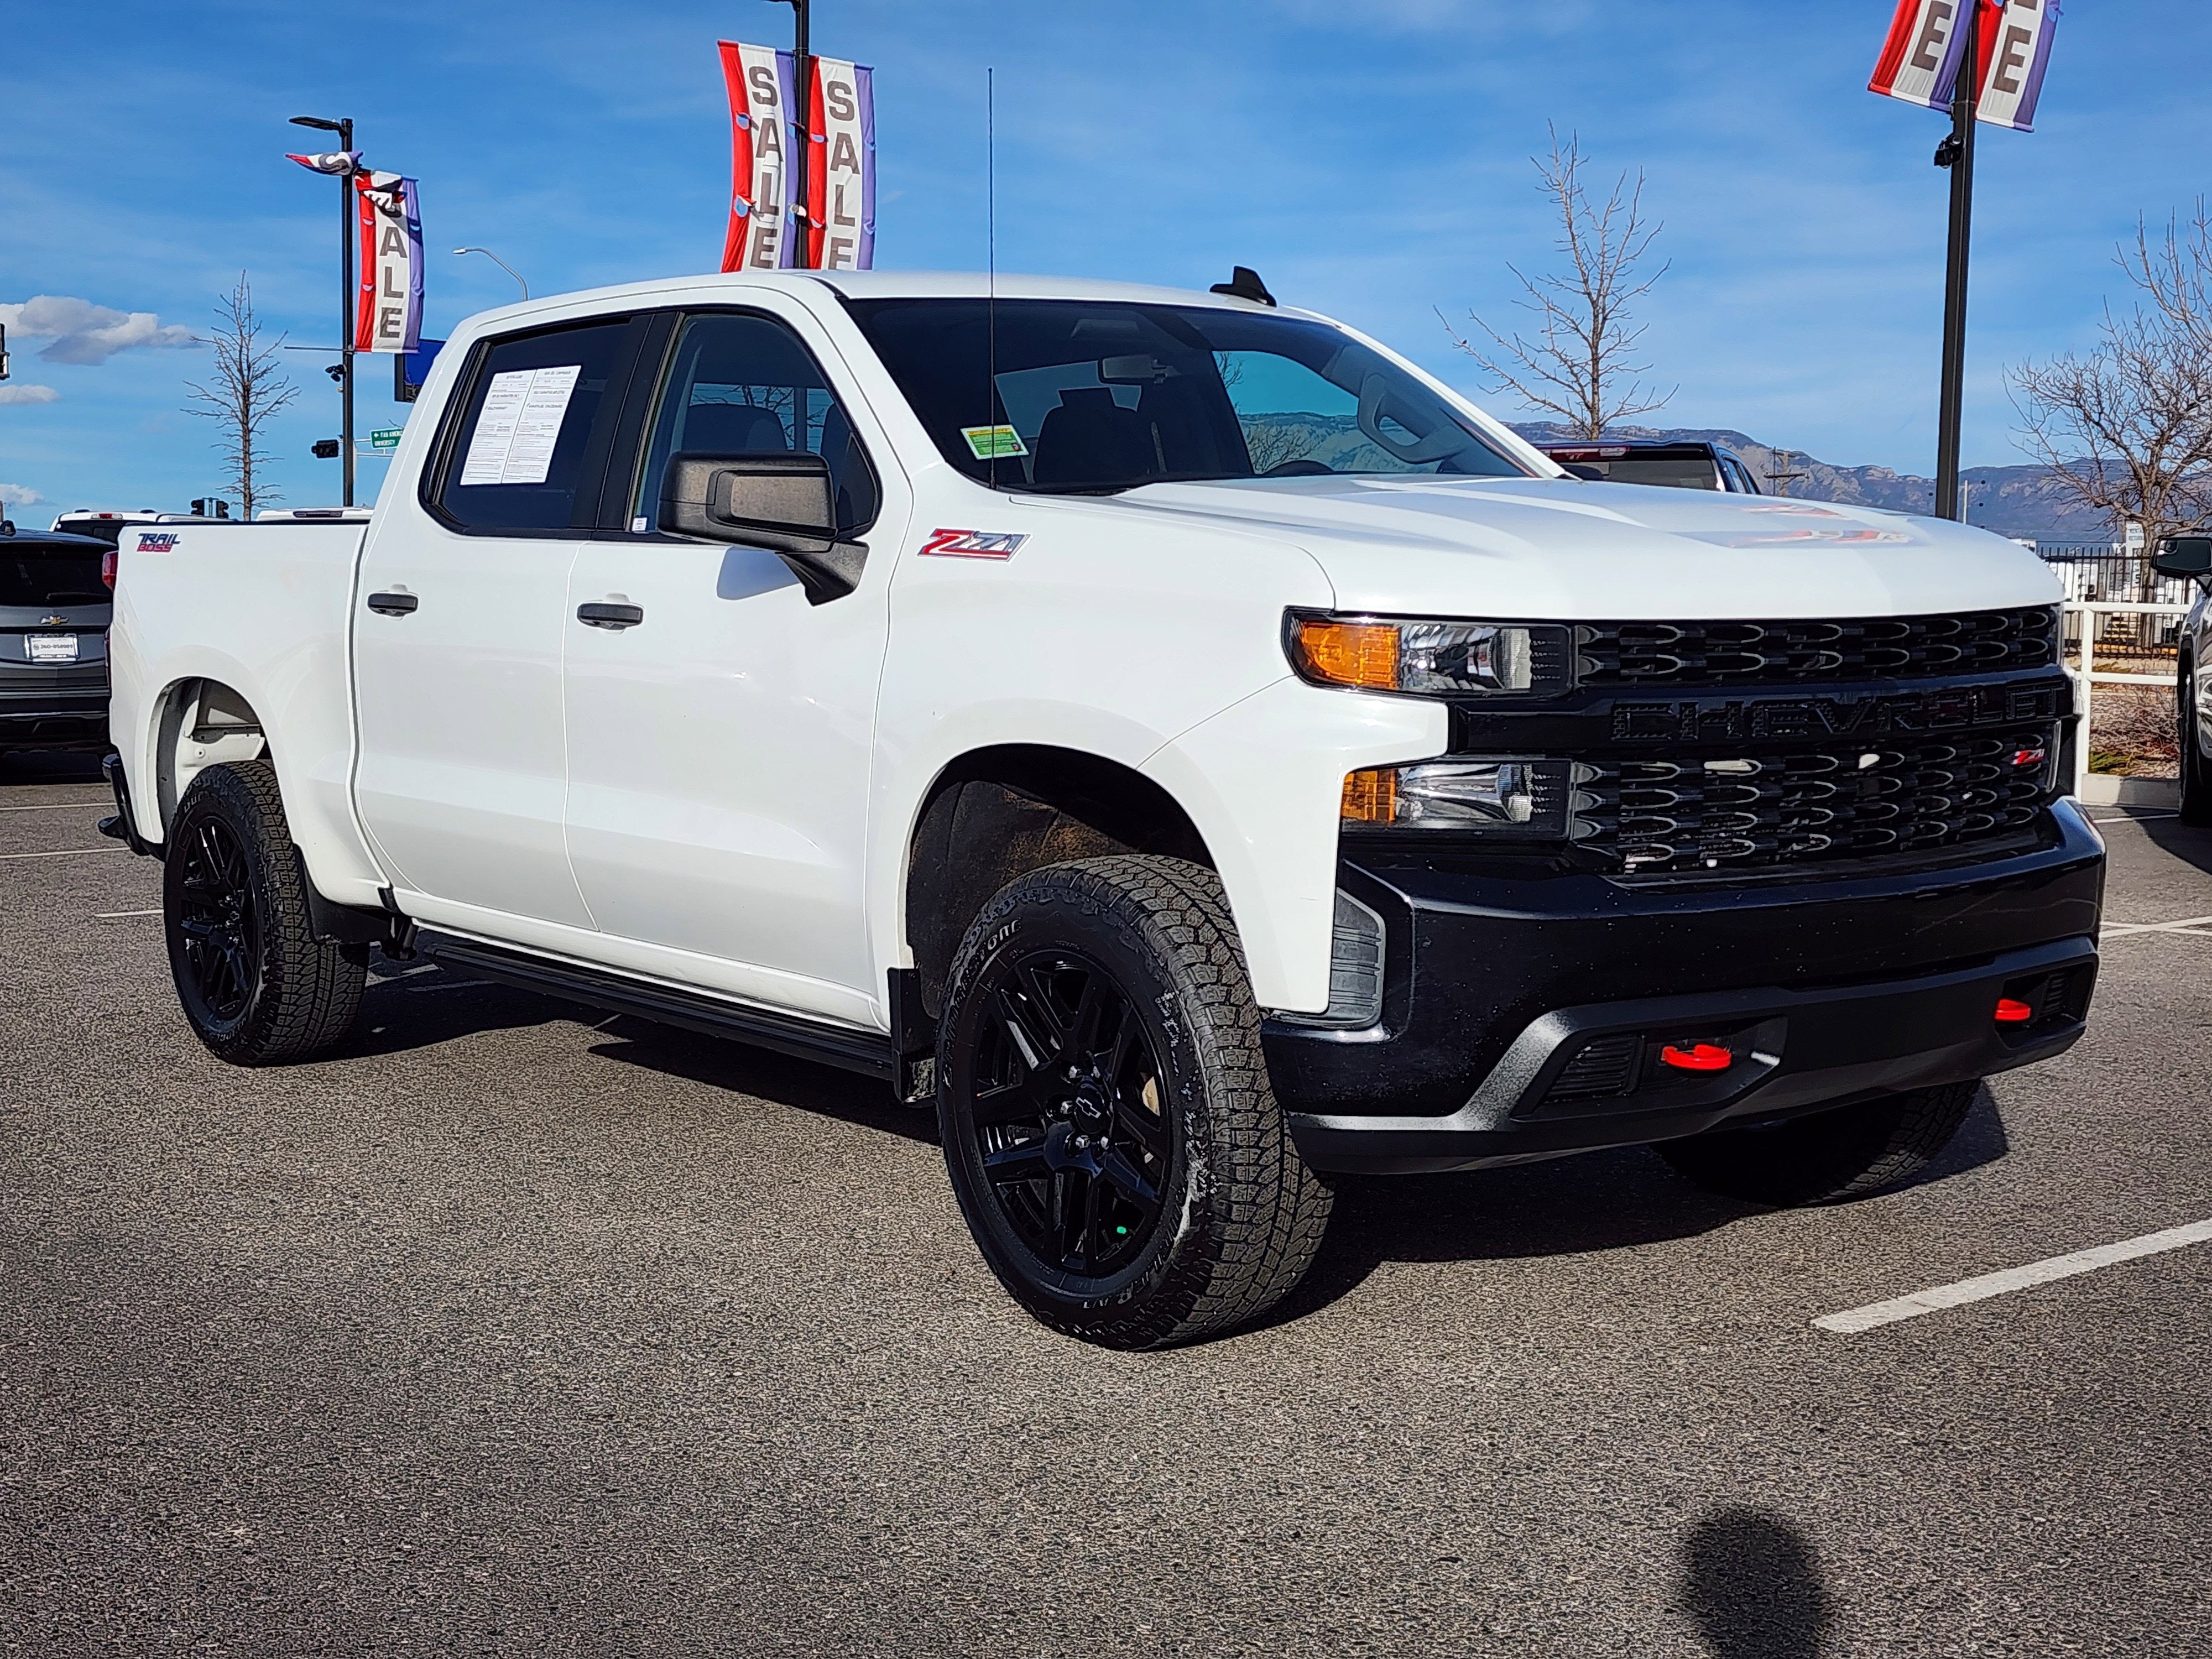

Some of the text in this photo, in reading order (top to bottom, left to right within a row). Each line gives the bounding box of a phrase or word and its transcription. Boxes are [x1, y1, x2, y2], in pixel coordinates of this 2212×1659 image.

[749, 66, 784, 269] SALE
[827, 80, 860, 270] SALE
[379, 226, 408, 338] ALE
[137, 544, 173, 553] BOSS
[138, 533, 181, 544] TRAIL
[917, 528, 1032, 562] Z71
[1611, 677, 2068, 740] CHEVROLET
[2011, 748, 2046, 766] Z71
